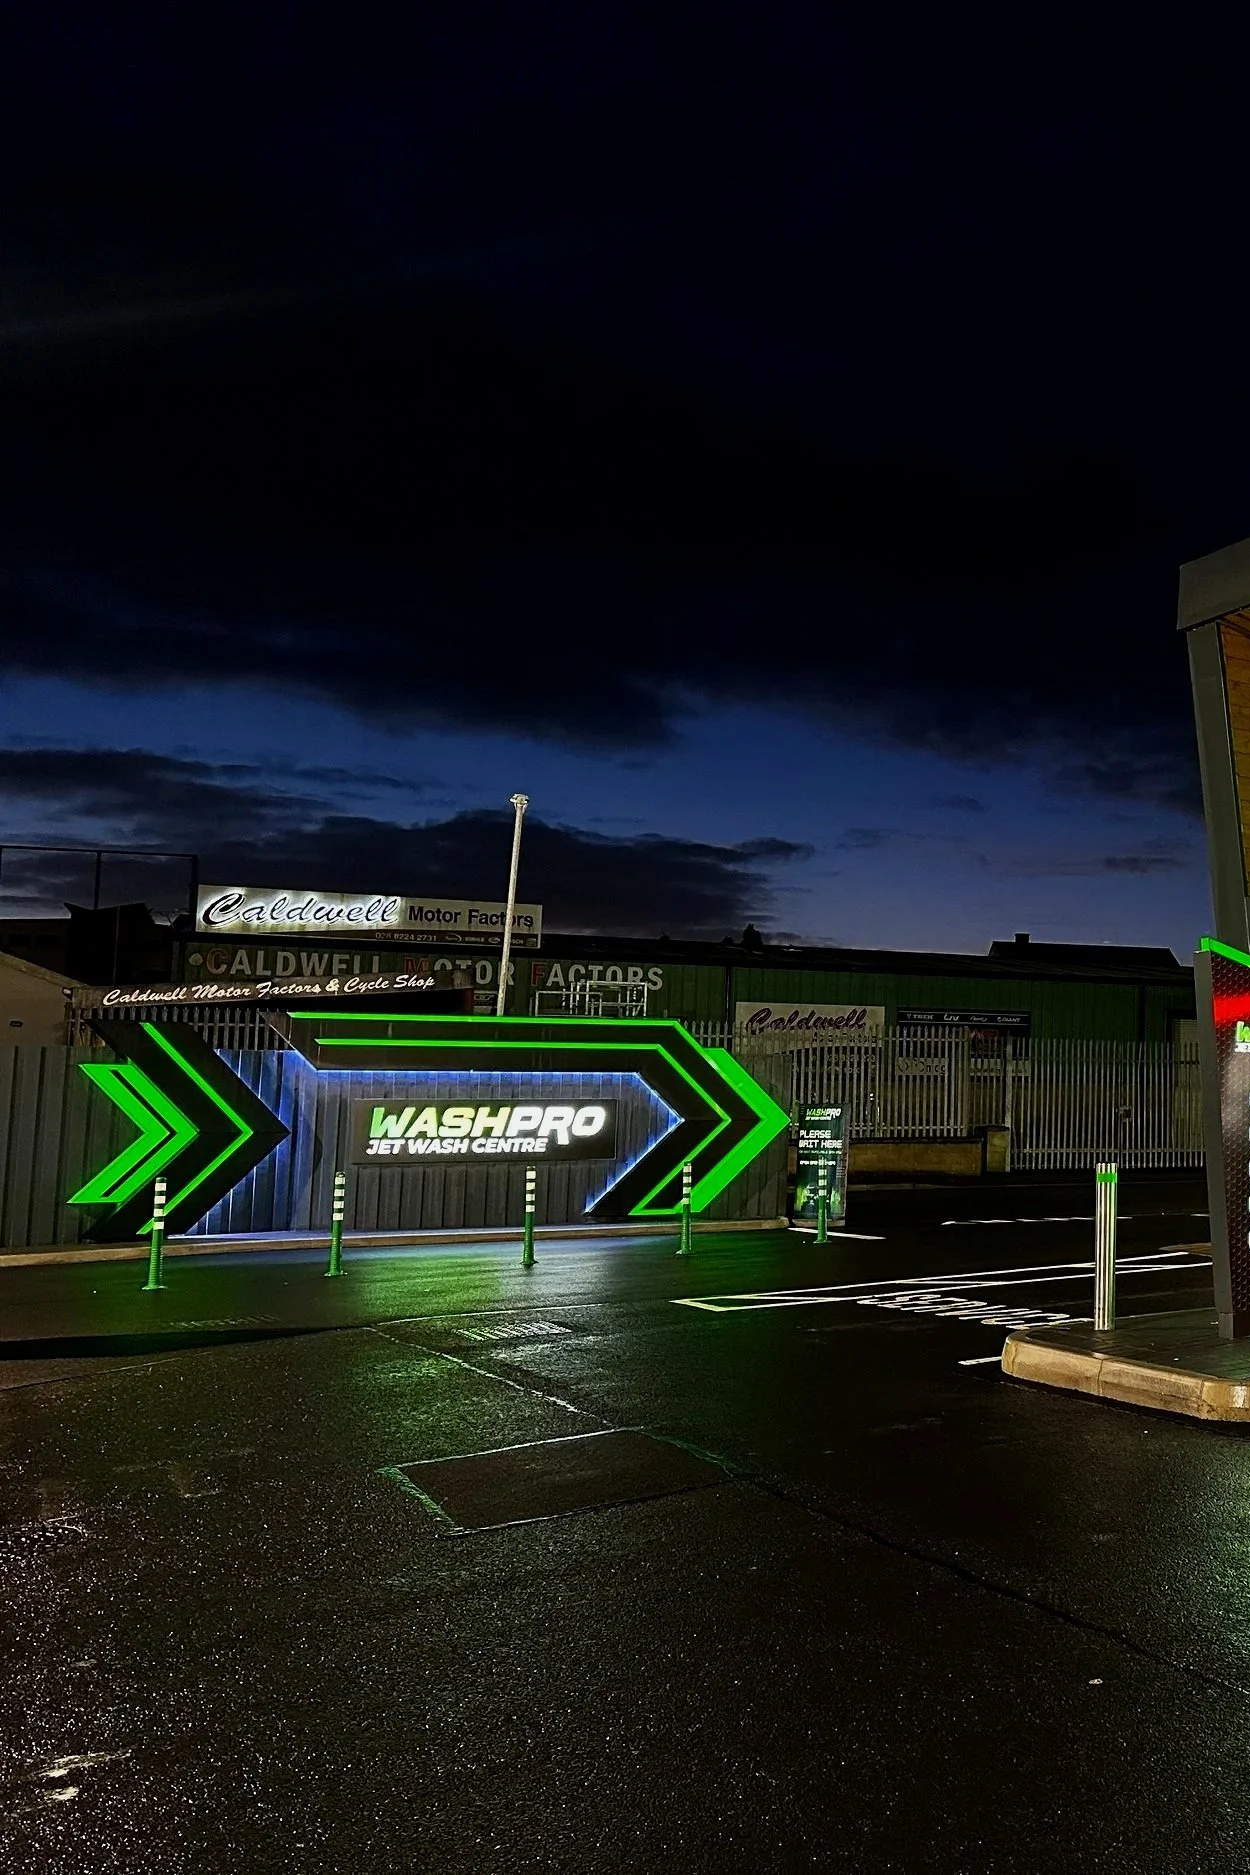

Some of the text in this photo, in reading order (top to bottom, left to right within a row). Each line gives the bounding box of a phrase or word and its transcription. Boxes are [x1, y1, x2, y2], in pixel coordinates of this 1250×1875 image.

[200, 892, 400, 927] Caldwell
[408, 905, 461, 924] Motor
[376, 932, 391, 940] 028
[416, 934, 437, 942] 2731
[102, 973, 435, 1006] Caldwell Motor Factors & Cycle Shop
[532, 961, 663, 991] FACTORS
[746, 1007, 867, 1035] Caldwell
[369, 1105, 607, 1145] WASHPRO
[806, 1108, 841, 1118] WASHPRO
[366, 1138, 548, 1155] JET WASH CENTRE
[799, 1130, 831, 1139] PLEASE
[820, 1140, 842, 1148] HERE
[857, 1294, 1095, 1329] SERVICE
